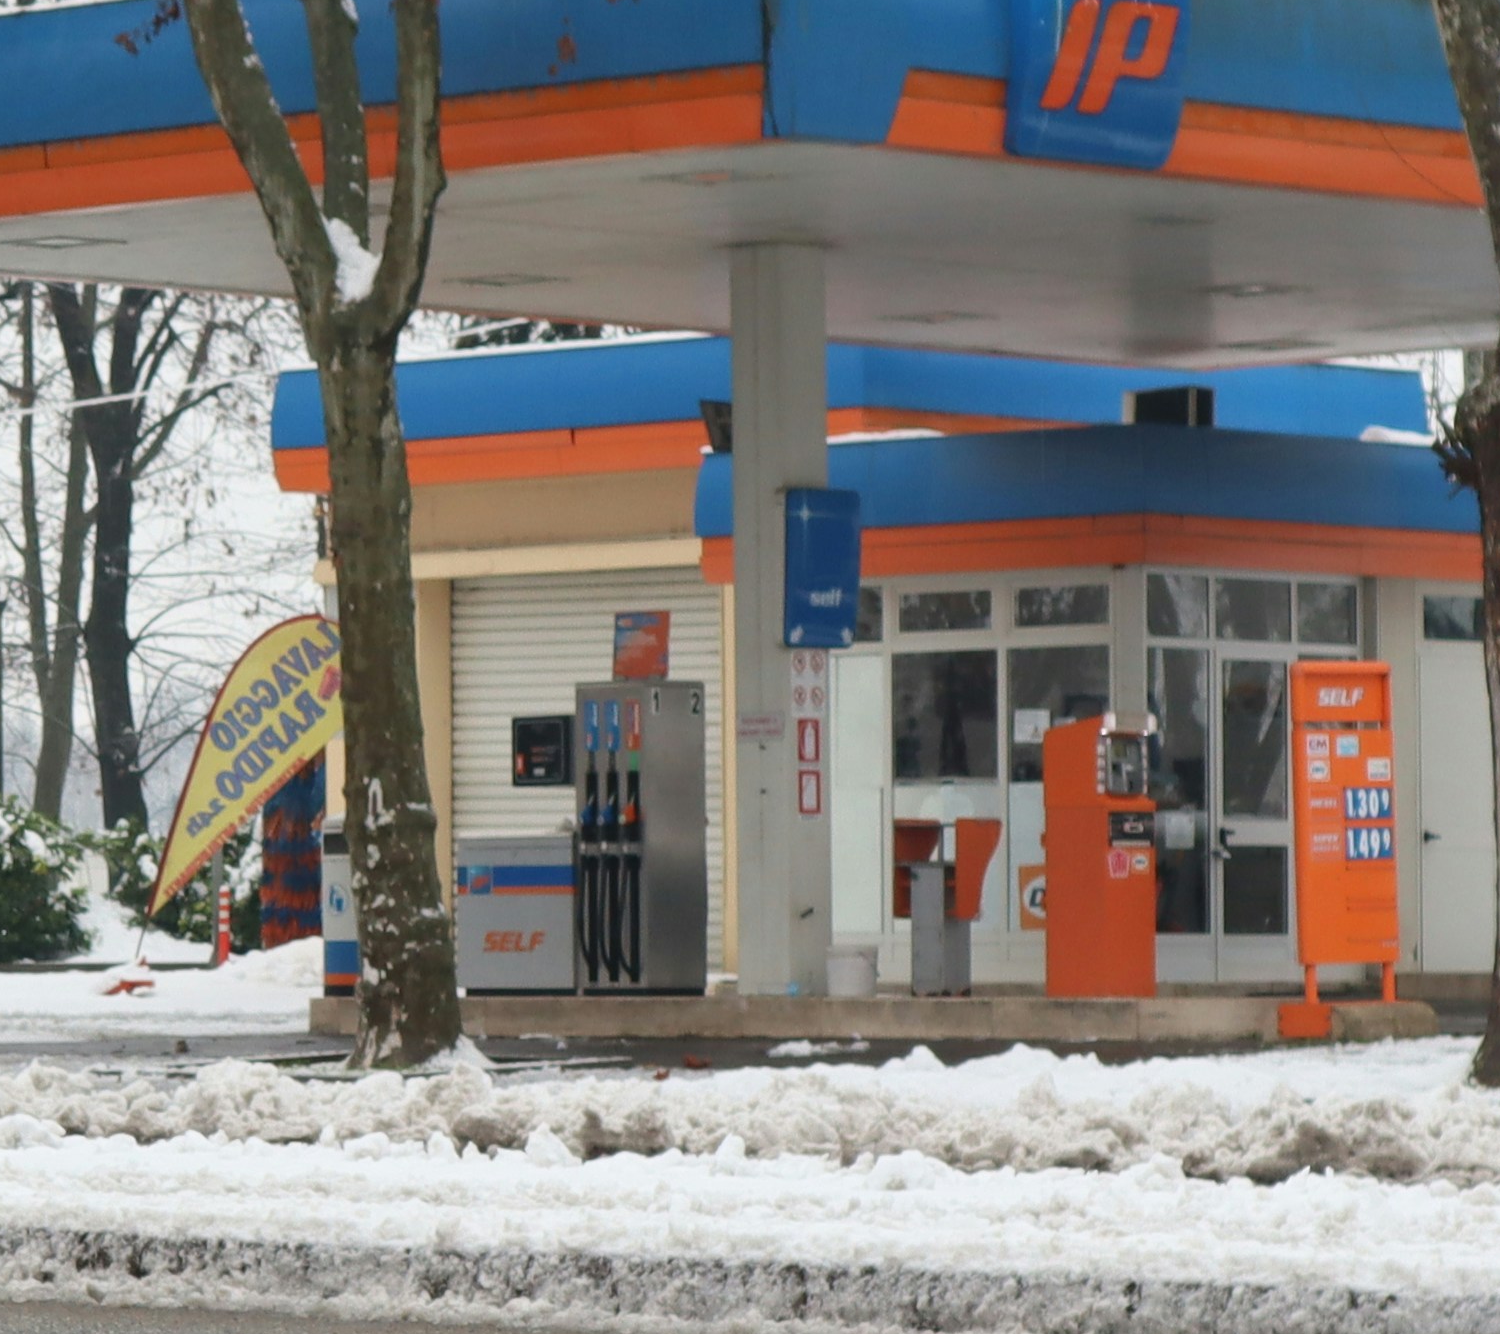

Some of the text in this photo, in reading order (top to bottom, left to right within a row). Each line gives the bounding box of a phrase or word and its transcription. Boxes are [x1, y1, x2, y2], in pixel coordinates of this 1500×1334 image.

[809, 588, 843, 607] self
[652, 690, 661, 713] 1
[691, 692, 701, 715] 2
[1317, 687, 1365, 708] SELF
[483, 929, 547, 954] SELF
